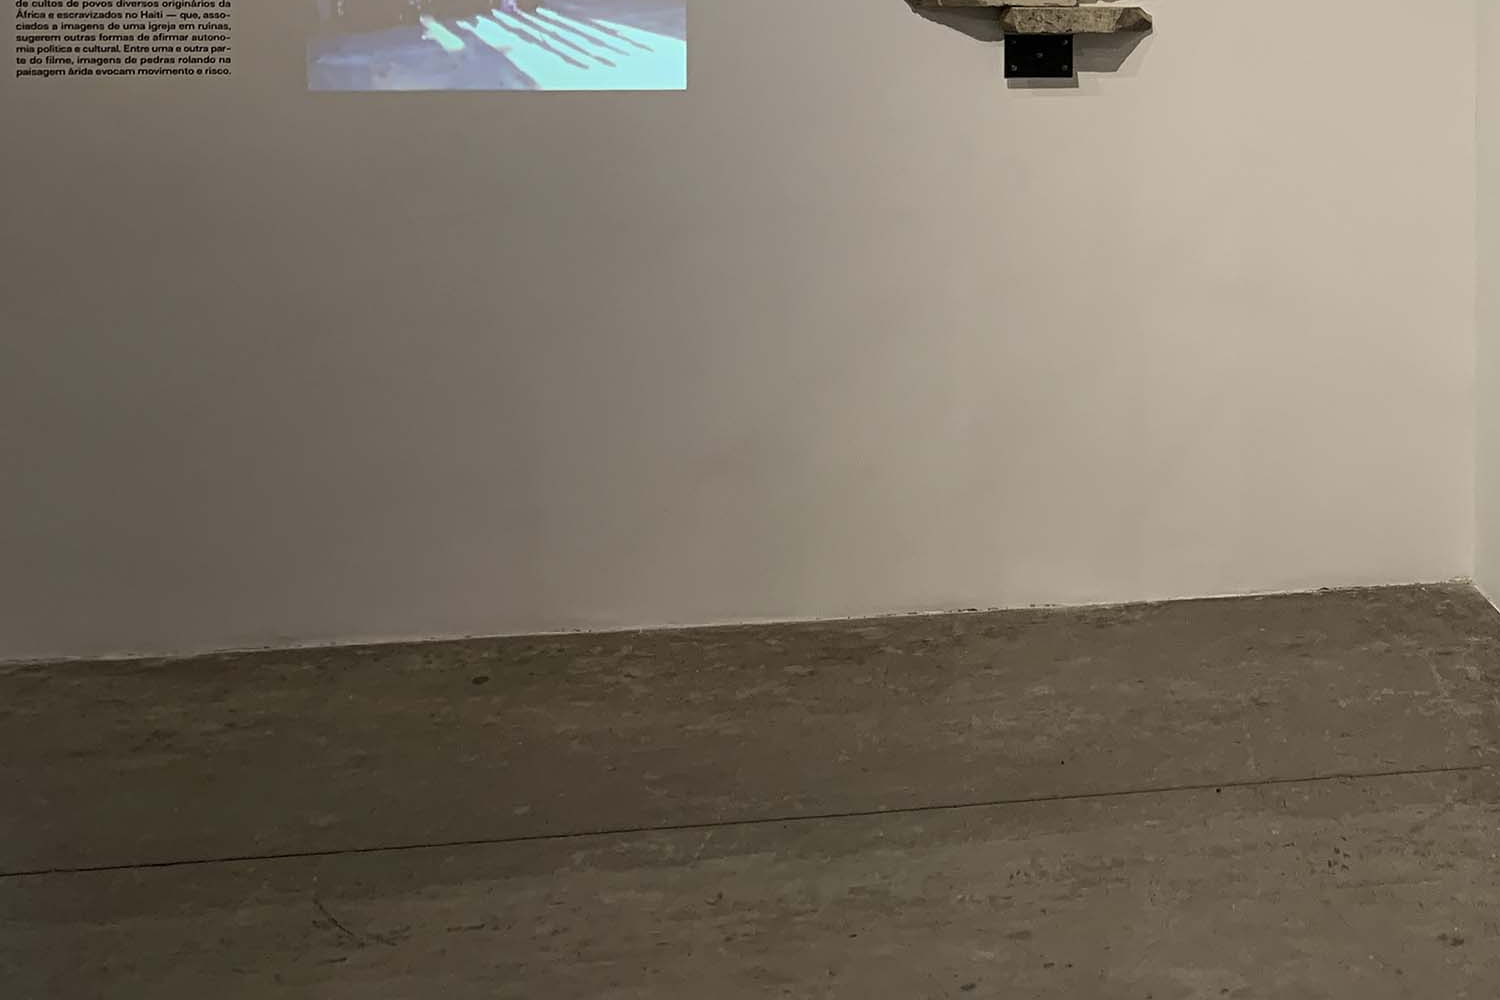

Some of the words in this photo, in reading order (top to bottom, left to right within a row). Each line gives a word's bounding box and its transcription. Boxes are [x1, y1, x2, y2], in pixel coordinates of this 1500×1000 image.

[32, 0, 63, 7] cultos
[66, 0, 79, 8] de
[82, 1, 113, 9] povos
[116, 0, 159, 8] diversos
[57, 11, 123, 19] escravizados
[16, 22, 49, 30] ciados
[61, 22, 105, 32] imagens
[148, 21, 176, 32] igreja
[16, 35, 61, 44] sugerem
[64, 31, 96, 42] outras
[99, 33, 134, 42] formas
[137, 33, 150, 41] de
[153, 31, 188, 41] afirmar
[16, 43, 35, 53] mia
[124, 44, 150, 53] Entre
[184, 45, 209, 53] outra
[77, 56, 122, 66] imagens
[140, 56, 175, 66] pedras
[178, 56, 216, 64] rolando
[16, 69, 66, 78] paisagem
[138, 67, 195, 75] movimento
